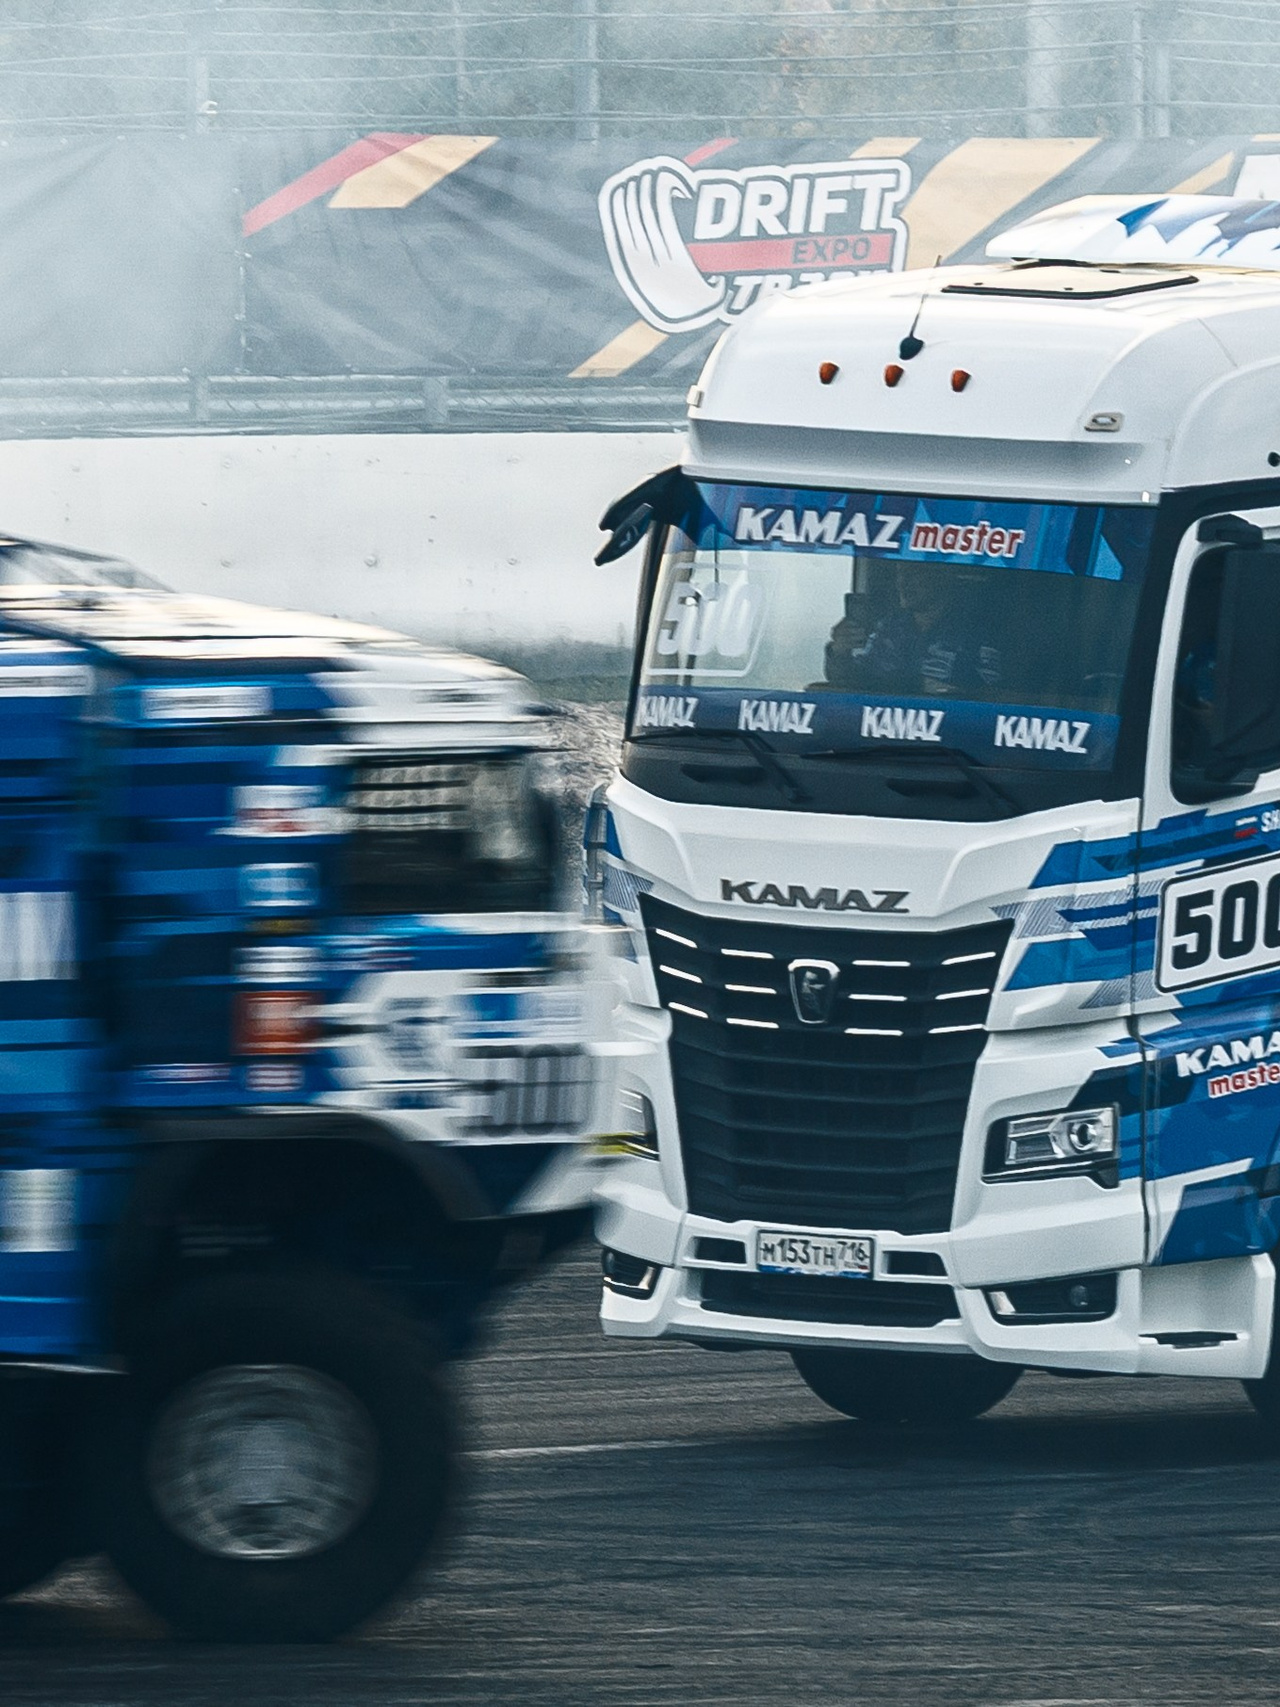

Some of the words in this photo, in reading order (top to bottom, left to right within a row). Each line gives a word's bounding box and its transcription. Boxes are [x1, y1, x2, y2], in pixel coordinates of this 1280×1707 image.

[694, 173, 898, 240] DRIFT
[791, 237, 873, 265] EXPO
[735, 506, 905, 549] KAMAZ
[909, 521, 1026, 558] master
[656, 581, 766, 657] 500
[635, 696, 699, 728] KAMAZ
[738, 699, 817, 734] KAMAZ
[861, 705, 945, 742] KAMAZ
[993, 715, 1091, 754] KAMAZ
[719, 878, 910, 914] KAMAZ
